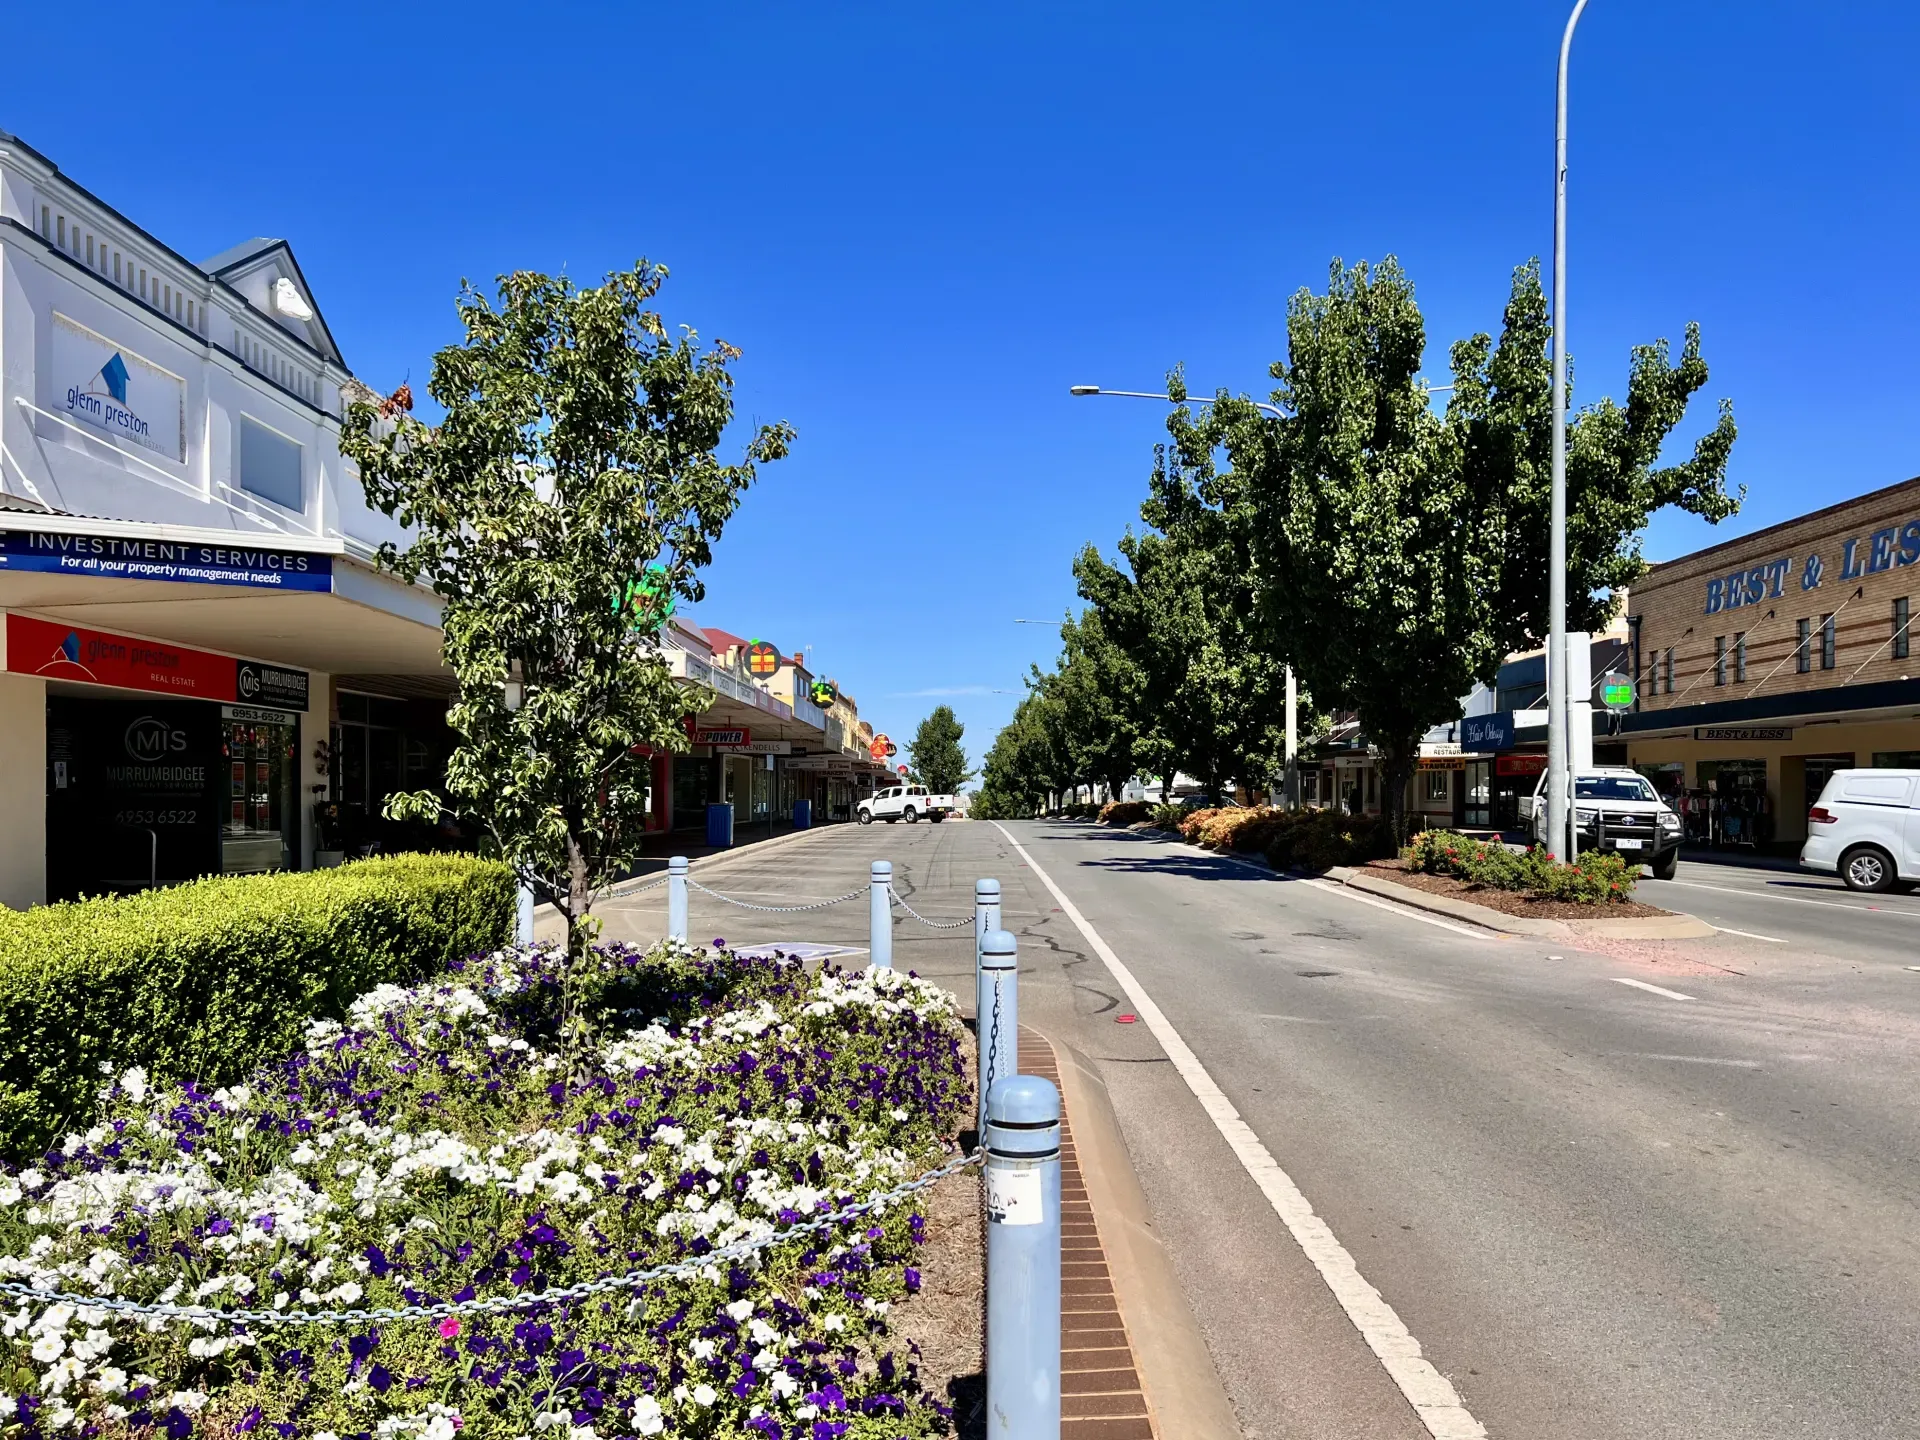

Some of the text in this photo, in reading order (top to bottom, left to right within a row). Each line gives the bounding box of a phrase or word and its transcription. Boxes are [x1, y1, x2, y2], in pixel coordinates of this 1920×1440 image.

[67, 385, 148, 436] glenn preston
[125, 430, 141, 445] REAL
[29, 532, 189, 560] INVESTMENT
[200, 548, 308, 572] SERVICES
[61, 555, 282, 584] For all your property management needs
[1704, 558, 1792, 615] BEST
[1801, 553, 1823, 591] &
[88, 636, 179, 668] glenn preston
[150, 673, 196, 688] REAL ESTATE
[243, 675, 260, 692] MIS
[232, 708, 286, 723] 6953-6522
[137, 730, 187, 751] MIS
[1466, 723, 1484, 743] Hair
[106, 766, 205, 781] MURRUMBIDGEE
[116, 810, 197, 824] 6953 6522
